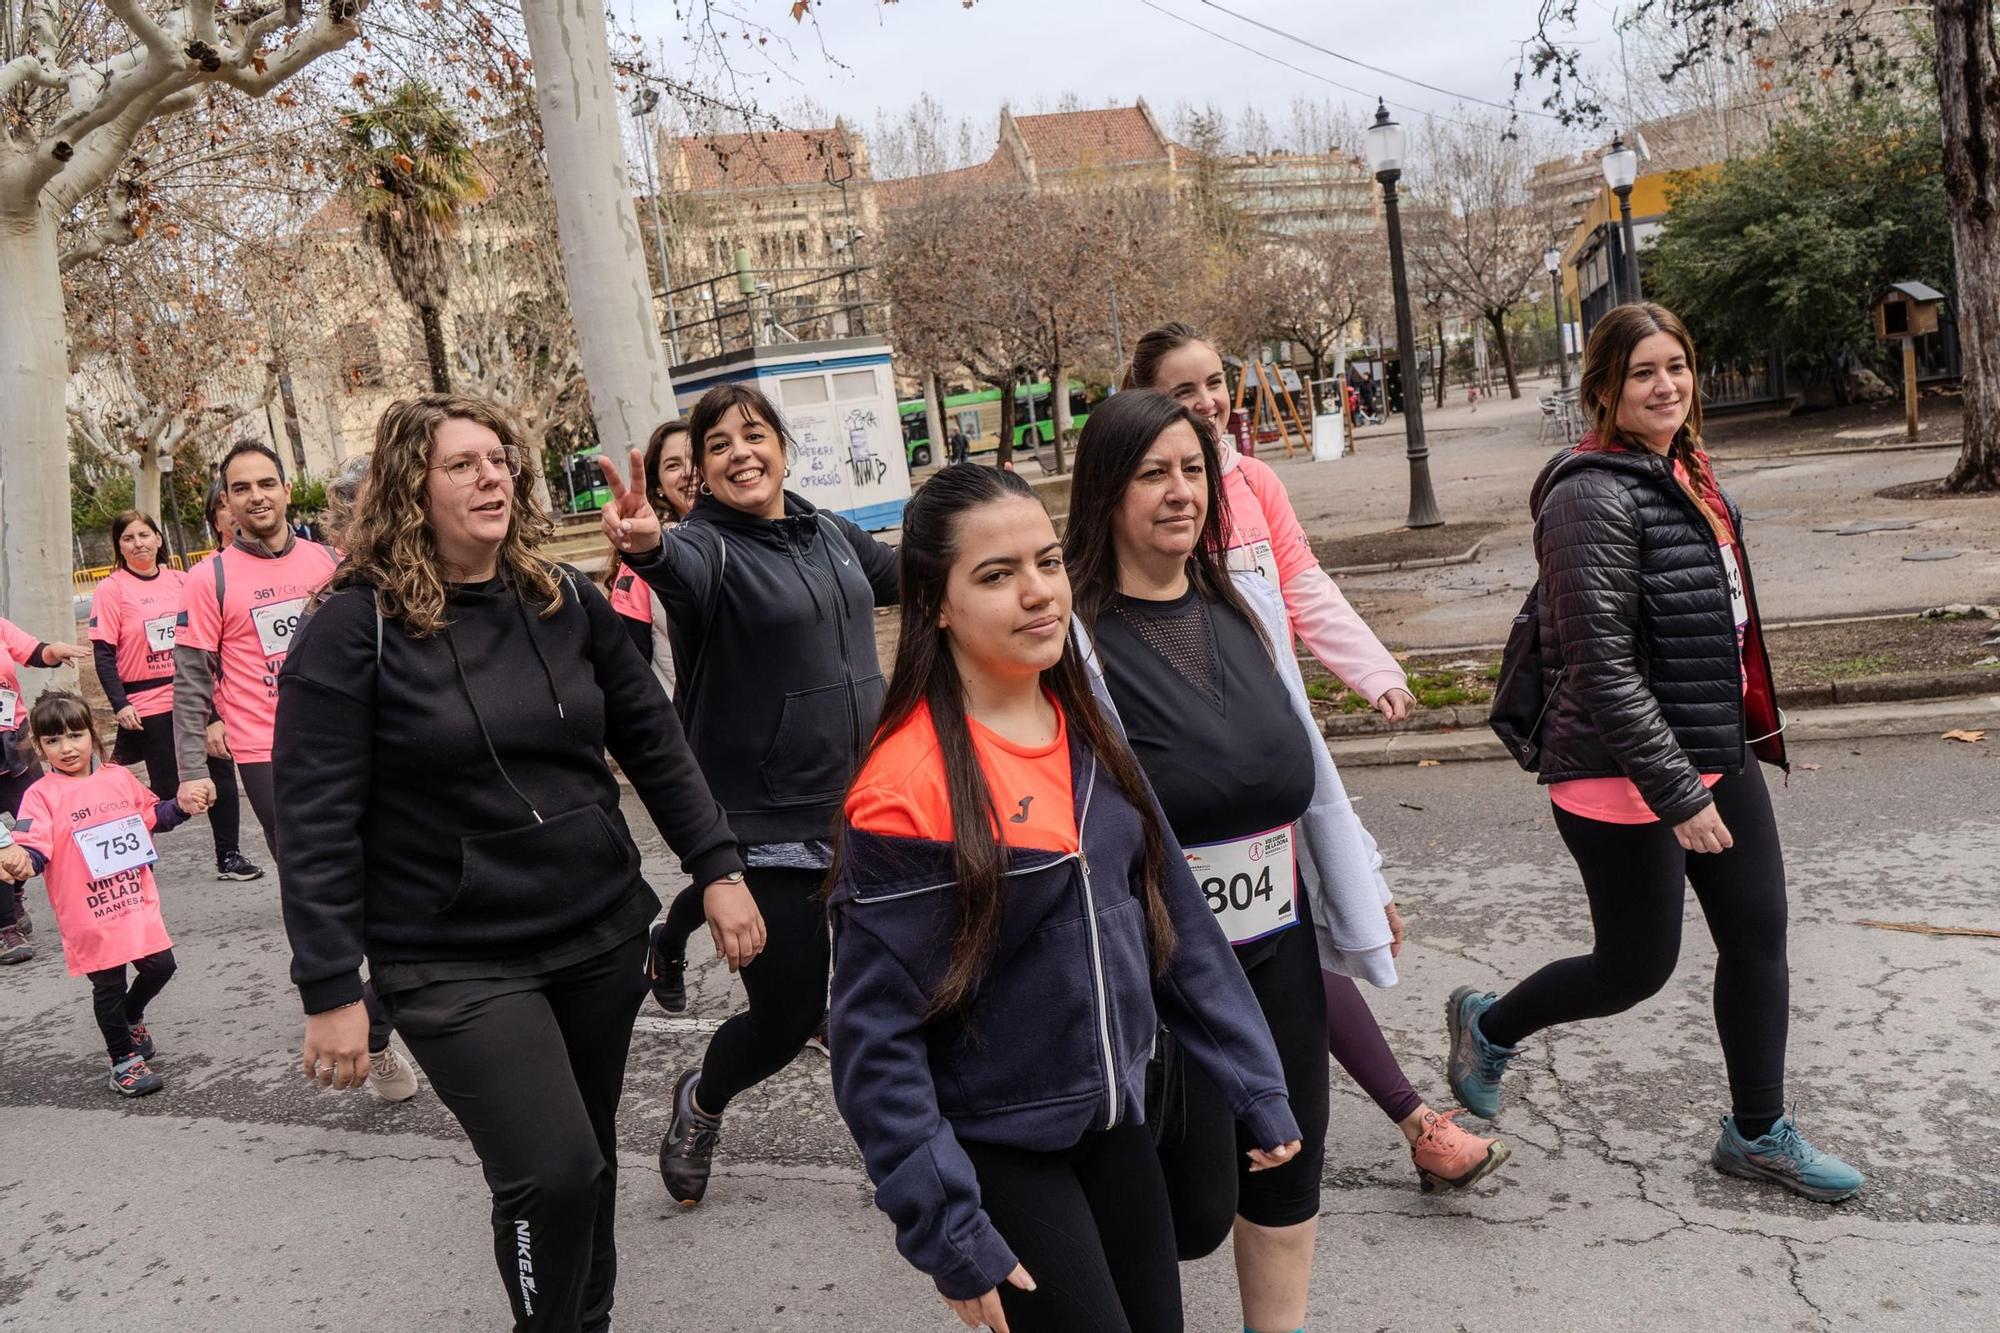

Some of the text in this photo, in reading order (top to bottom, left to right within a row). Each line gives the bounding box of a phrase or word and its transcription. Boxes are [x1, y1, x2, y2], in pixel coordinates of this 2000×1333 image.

[254, 588, 276, 600] 361
[156, 626, 176, 641] 75
[273, 615, 299, 637] 69
[71, 808, 92, 823] 361
[98, 800, 130, 814] Group
[96, 832, 141, 861] 753
[86, 881, 144, 909] DE LA D
[1201, 866, 1273, 914] 804
[94, 896, 145, 919] MANRESA
